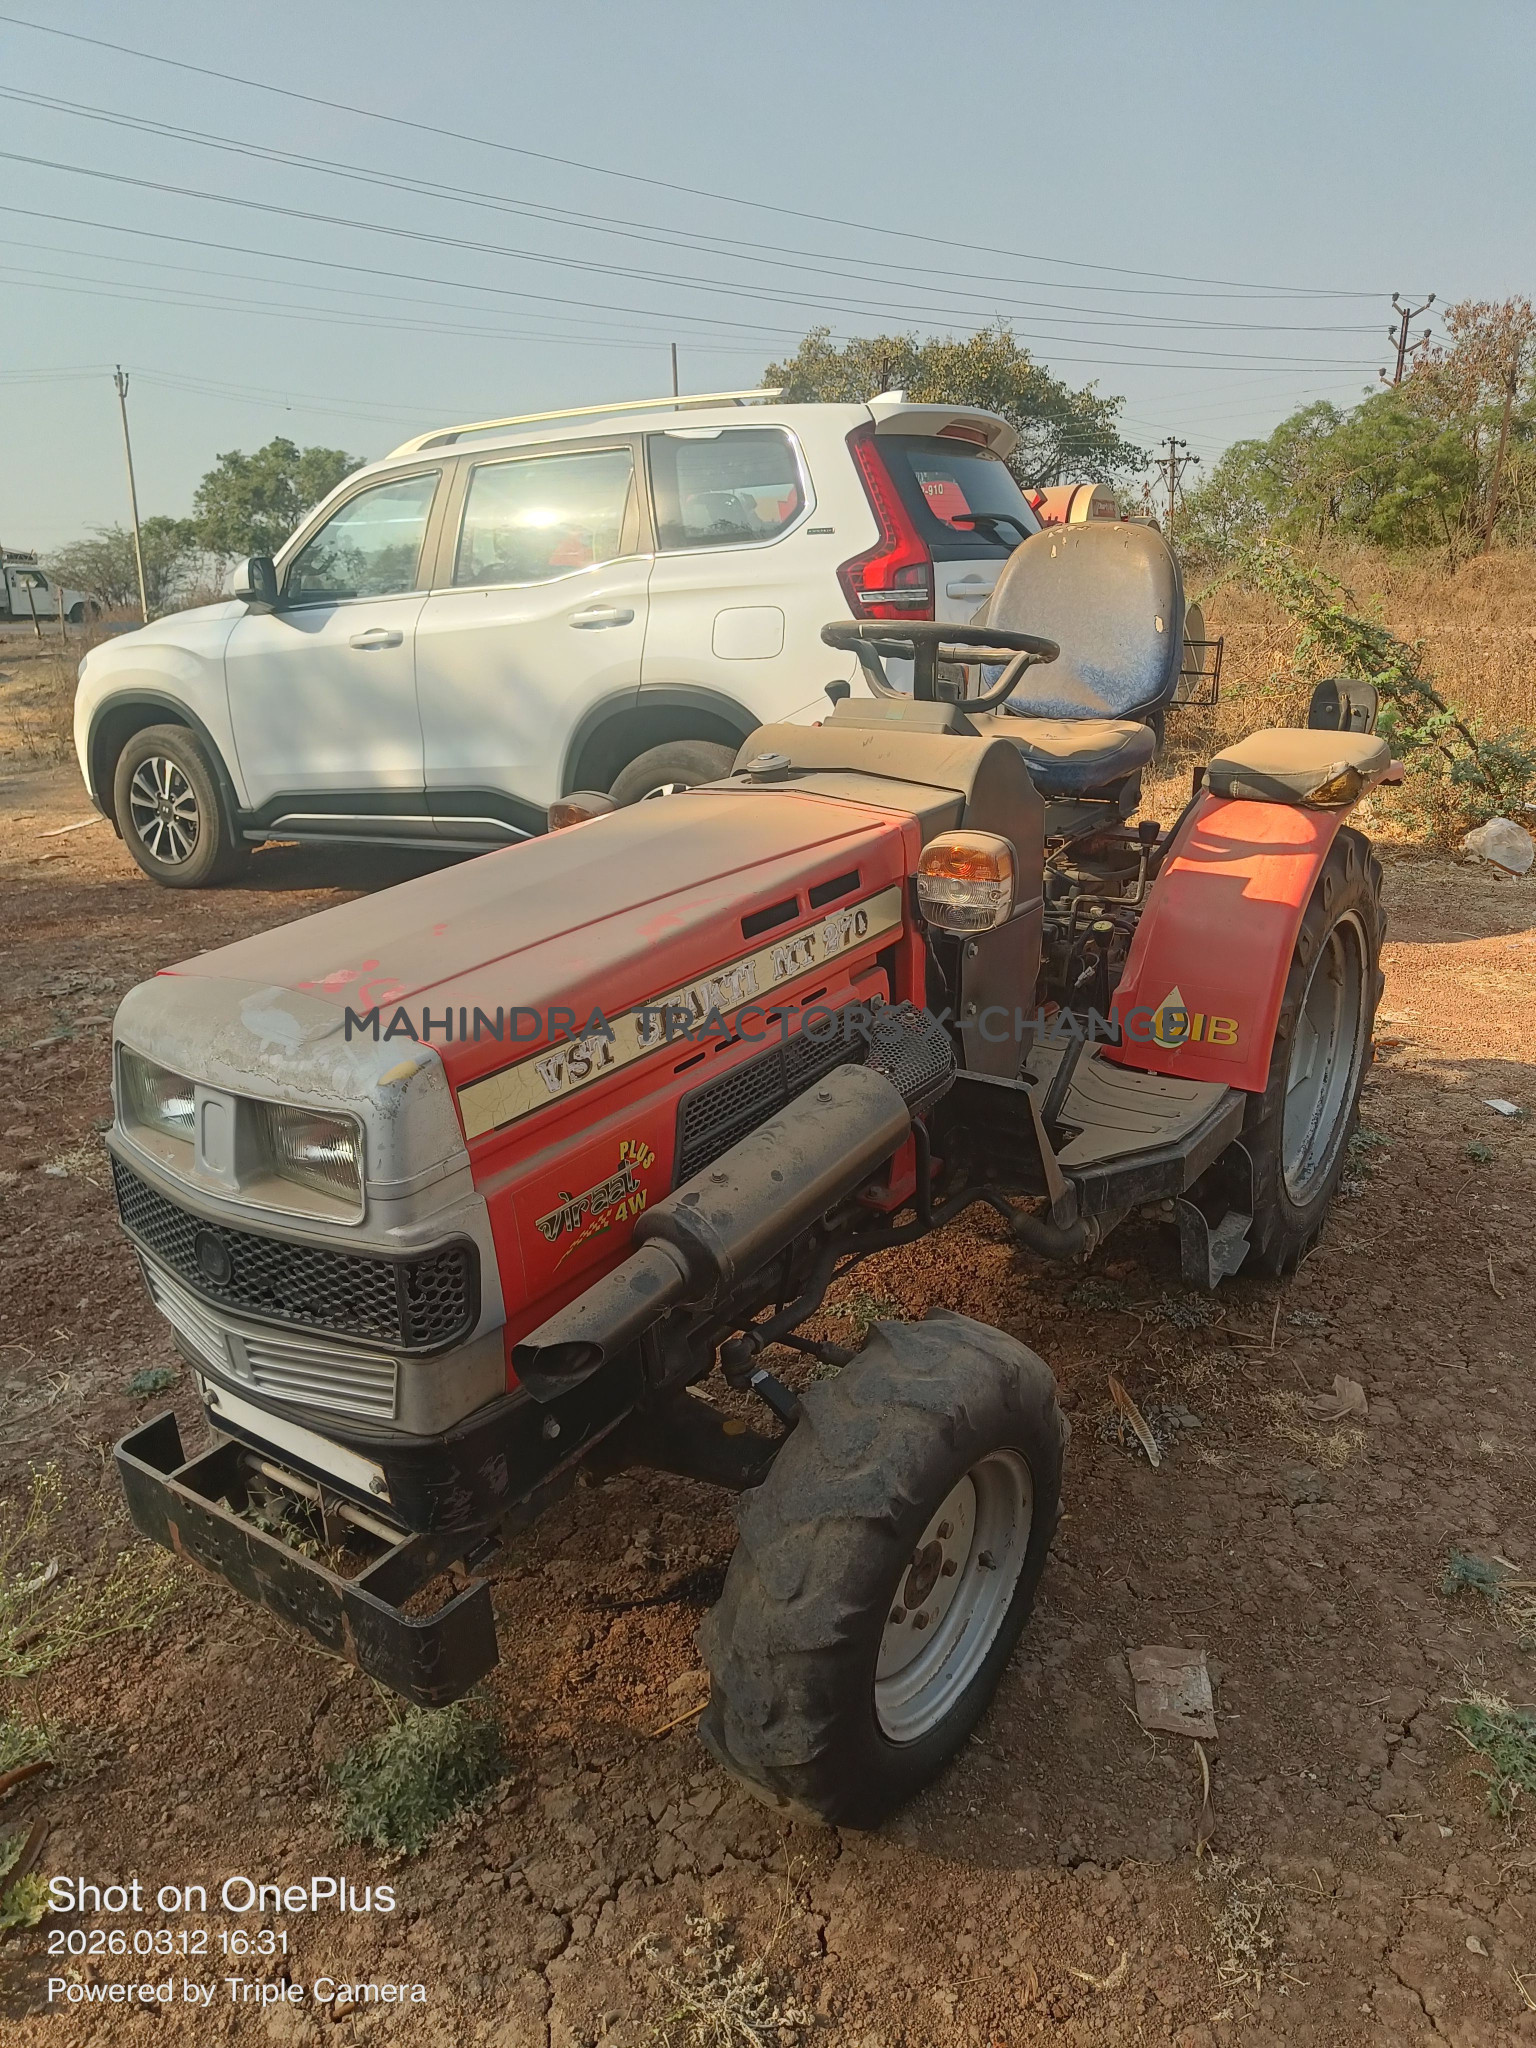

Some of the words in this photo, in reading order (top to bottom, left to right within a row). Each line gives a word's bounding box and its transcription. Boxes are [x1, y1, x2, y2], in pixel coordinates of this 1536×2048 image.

[535, 1027, 616, 1094] VST
[770, 931, 816, 981] MT
[822, 908, 868, 958] 270
[620, 1140, 655, 1169] PLUS
[615, 1188, 648, 1222] 4W
